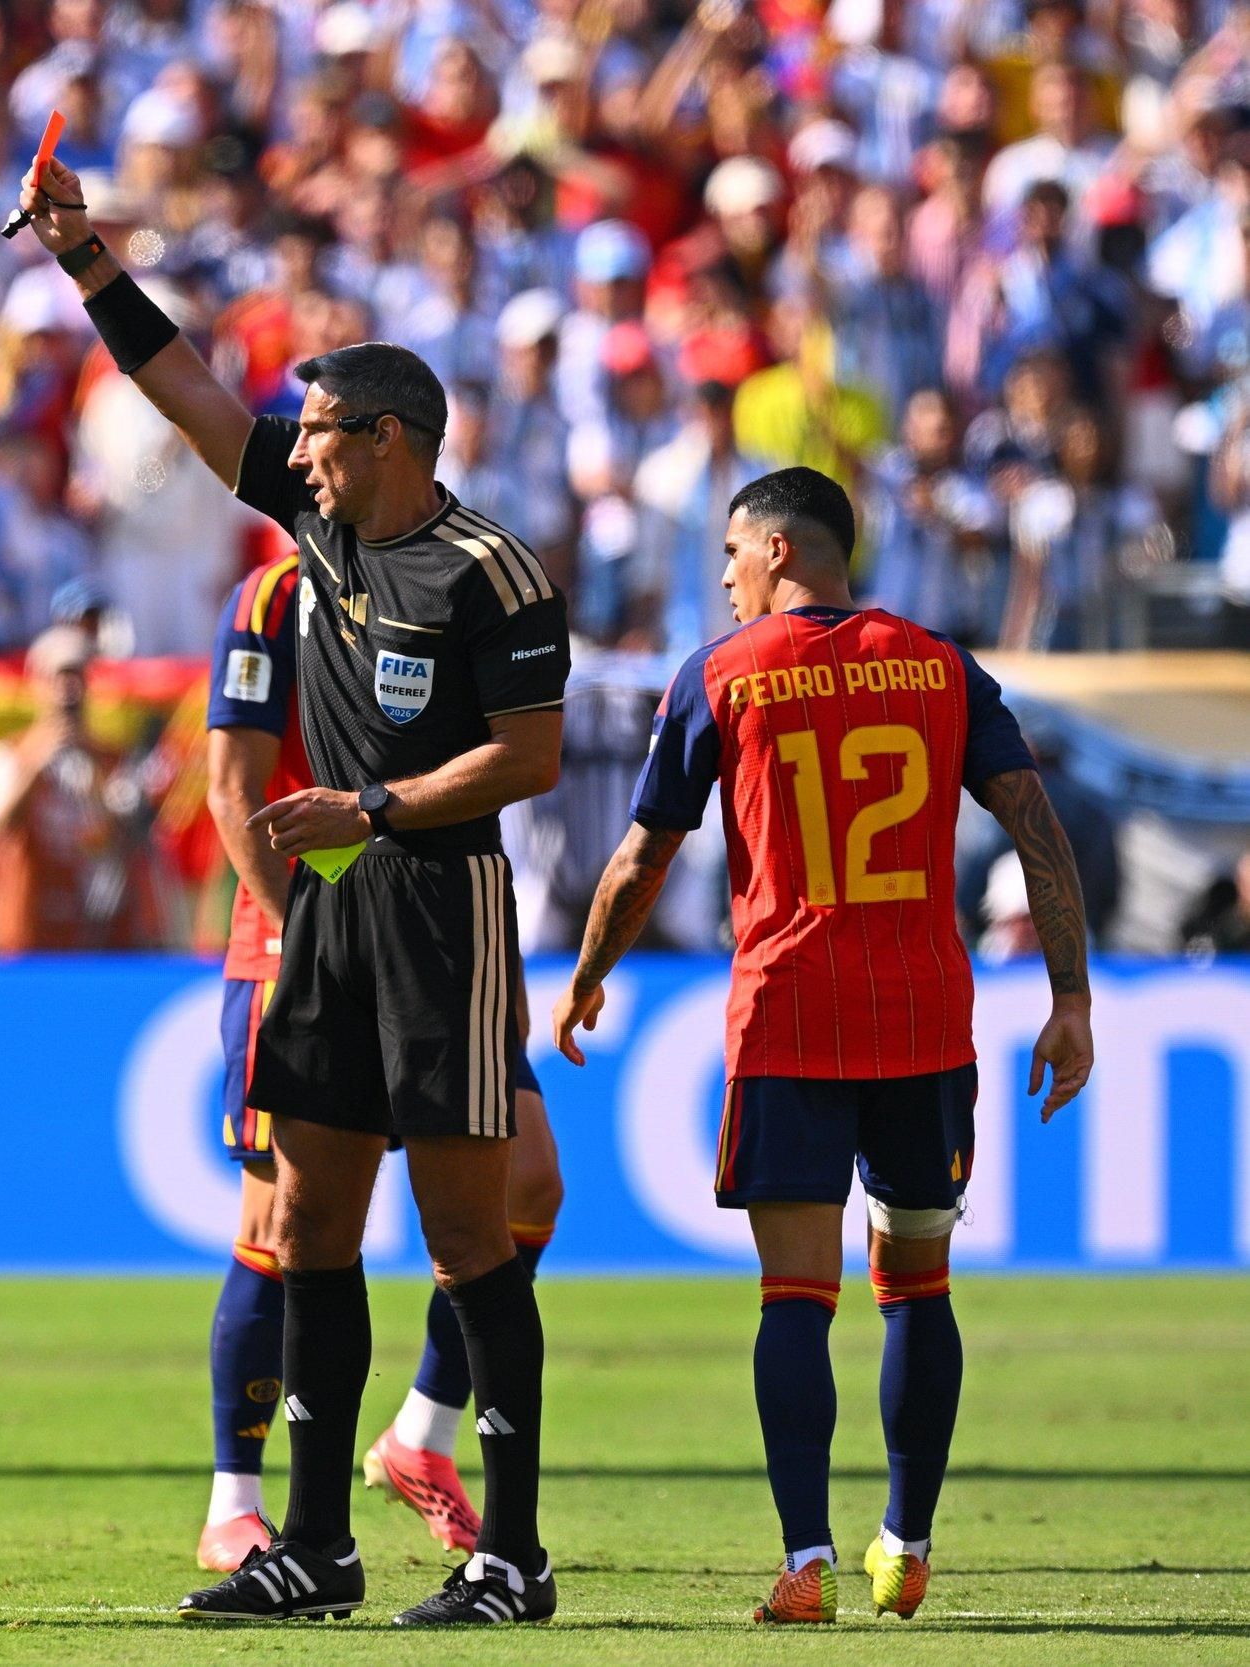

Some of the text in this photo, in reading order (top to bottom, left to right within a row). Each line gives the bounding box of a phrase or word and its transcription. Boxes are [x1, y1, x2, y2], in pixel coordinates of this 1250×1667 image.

[511, 643, 557, 661] Hisense
[381, 657, 428, 678] FIFA
[379, 683, 427, 698] REFEREE
[729, 658, 947, 713] PEDRO PORRO
[389, 708, 411, 718] 2026
[776, 724, 930, 906] 12
[329, 865, 343, 879] FIFA
